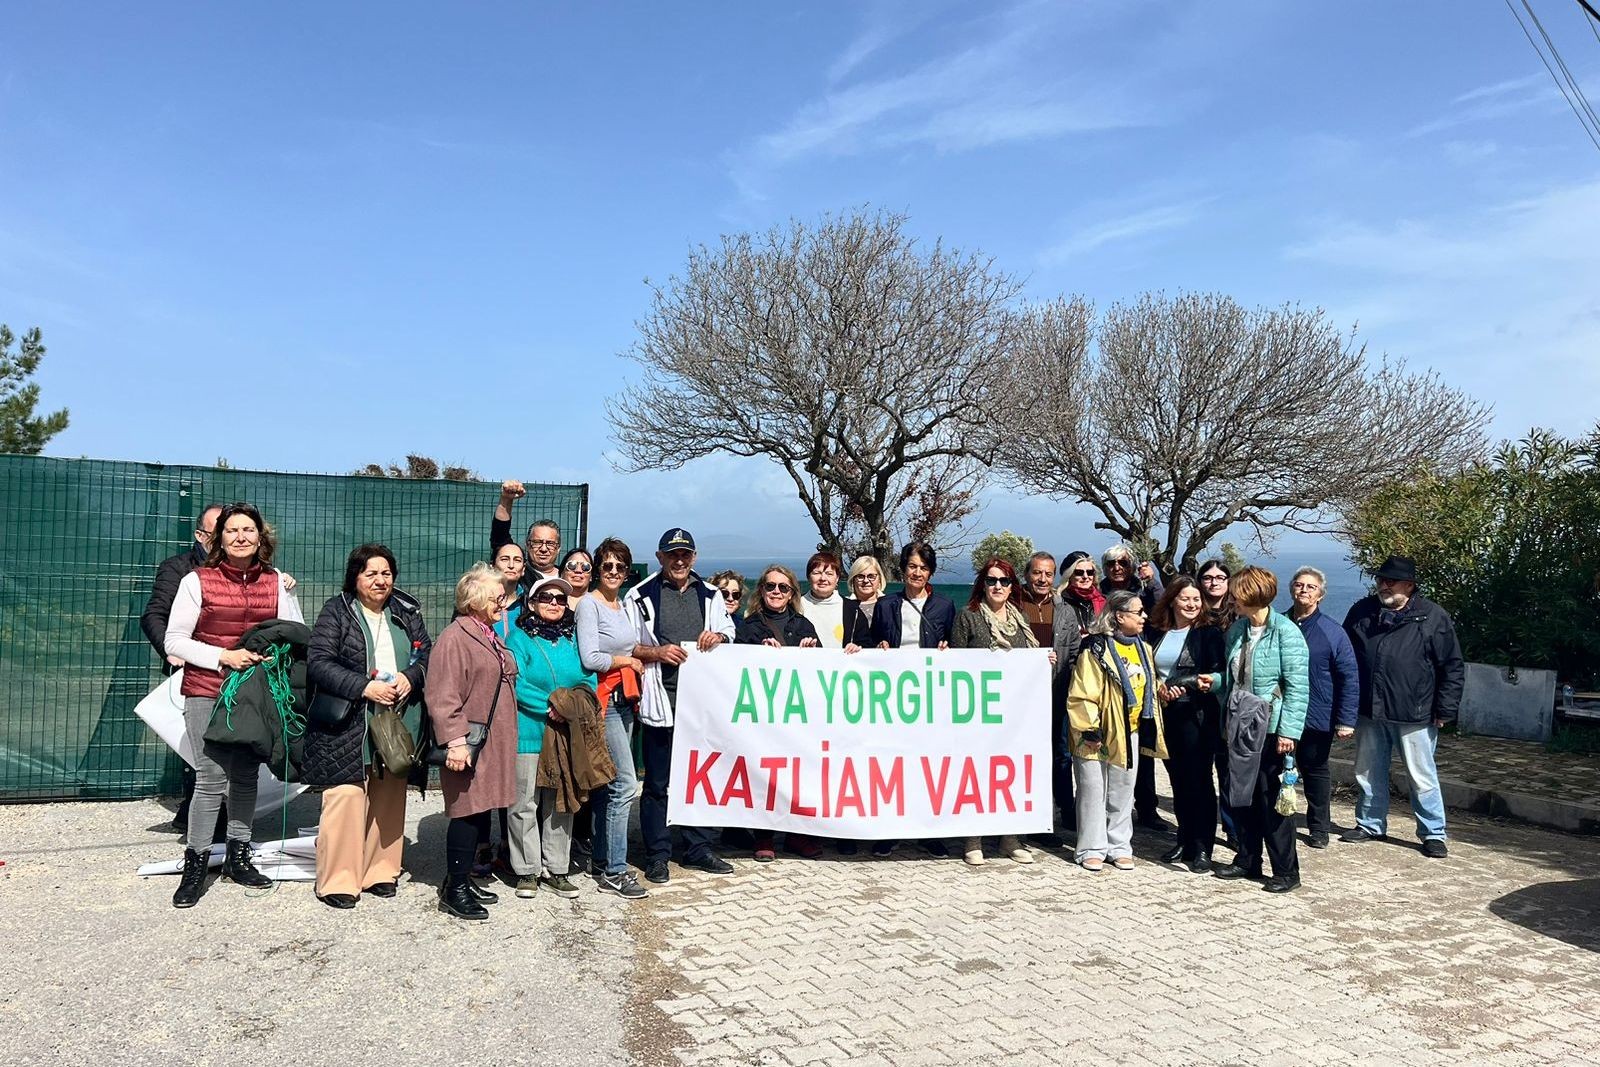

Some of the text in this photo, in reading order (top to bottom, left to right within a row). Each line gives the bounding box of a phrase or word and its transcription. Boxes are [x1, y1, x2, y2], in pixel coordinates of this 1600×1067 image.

[731, 657, 1003, 724] AYA YORGİ'DE
[685, 740, 1033, 818] KATLİAM VAR!
